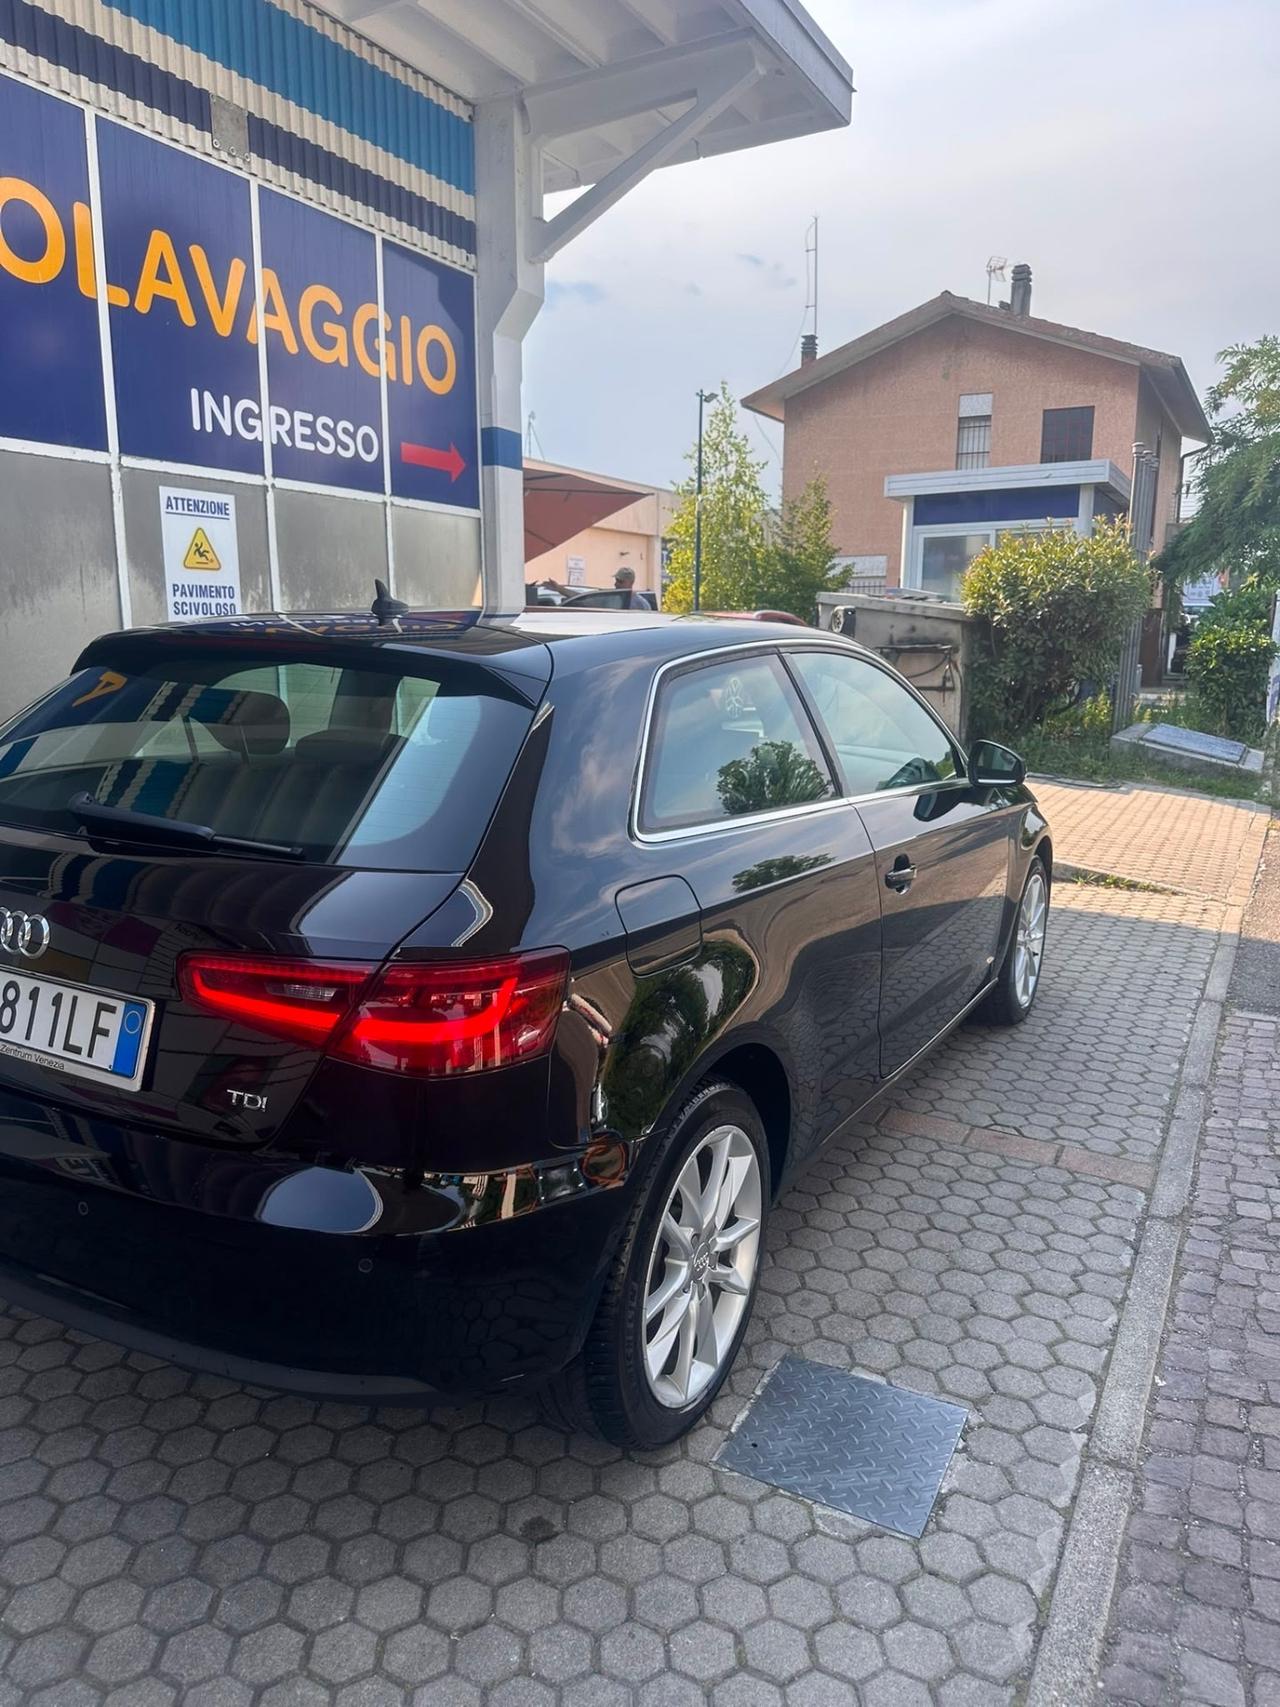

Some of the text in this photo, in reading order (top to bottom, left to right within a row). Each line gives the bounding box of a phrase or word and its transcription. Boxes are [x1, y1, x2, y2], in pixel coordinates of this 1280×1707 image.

[0, 177, 456, 395] OLAVAGGIO
[191, 388, 379, 463] INGRESSO
[166, 496, 230, 516] ATTENZIONE
[172, 583, 235, 599] PAVIMENTO
[173, 601, 237, 616] SCIVOLOSO
[0, 980, 117, 1058] 811LF
[0, 1044, 65, 1070] Zentrum Venezia
[226, 1089, 268, 1112] TDI
